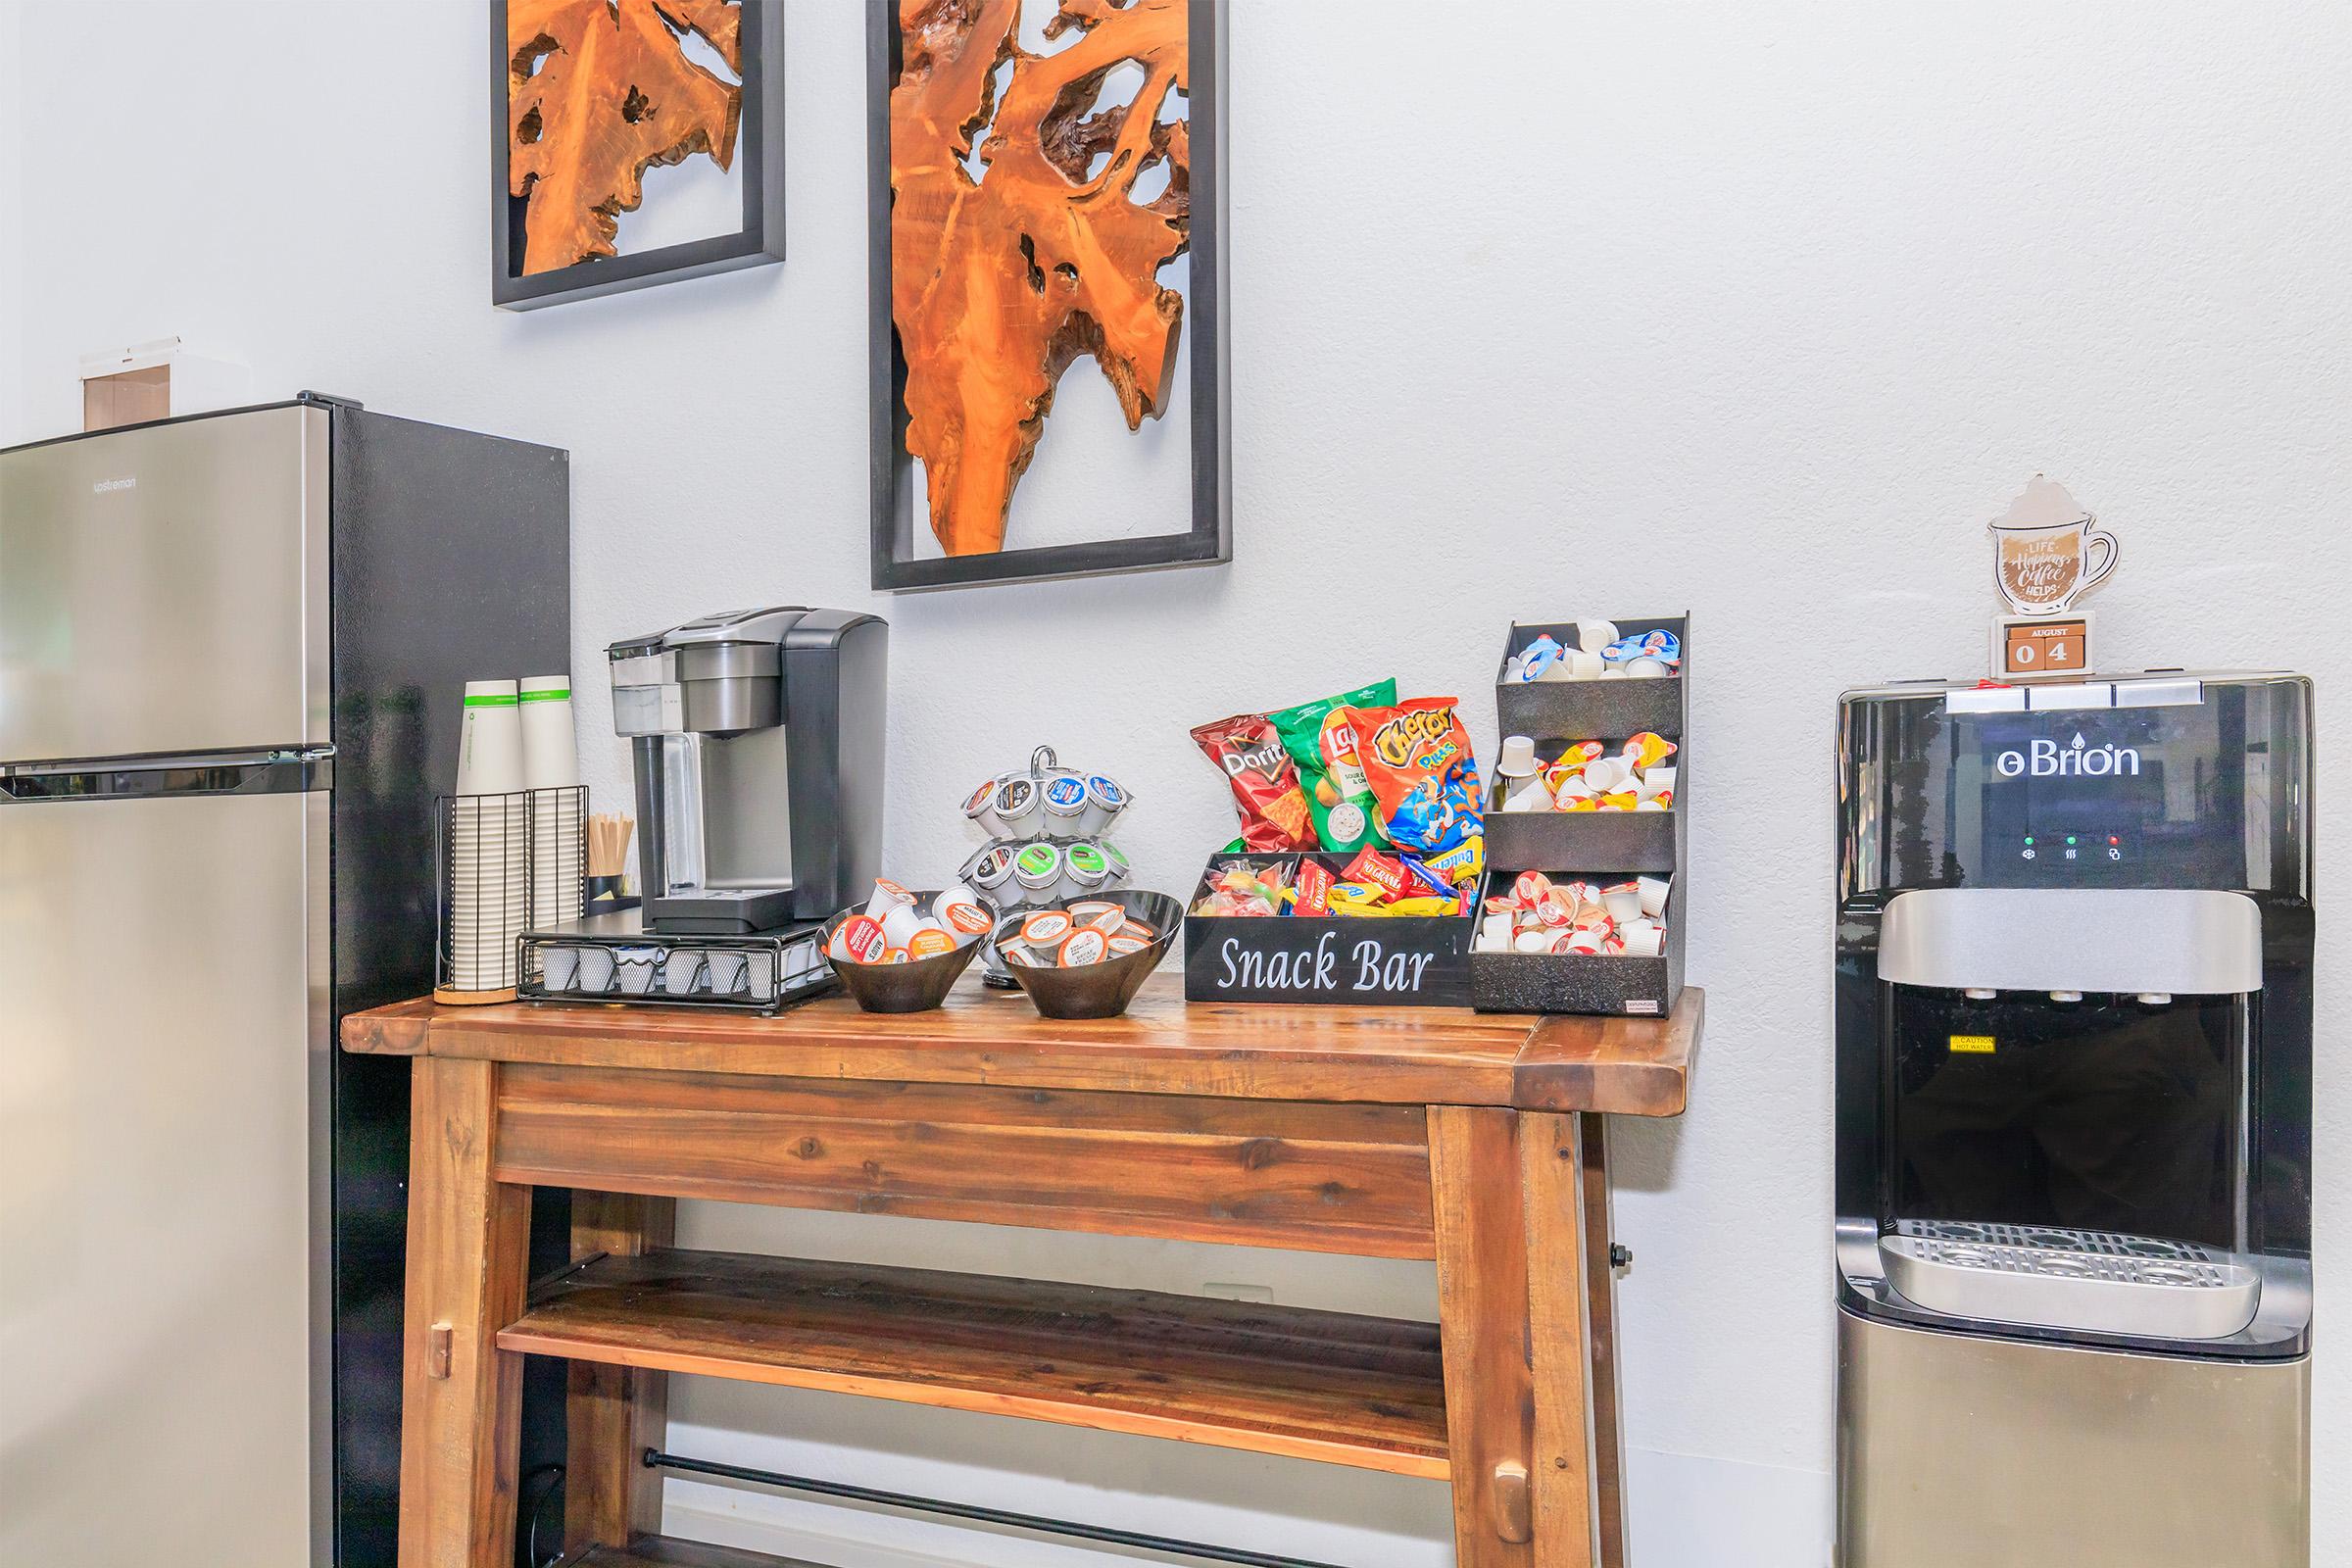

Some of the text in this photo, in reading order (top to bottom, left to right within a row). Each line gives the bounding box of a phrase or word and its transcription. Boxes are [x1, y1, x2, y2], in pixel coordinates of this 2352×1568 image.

[2029, 541, 2055, 554] LIFE
[2017, 564, 2065, 587] Coffee
[2025, 585, 2057, 597] HELPS
[2032, 628, 2069, 637] AUGUST
[1325, 726, 1352, 759] La
[1222, 743, 1285, 776] Dorit
[1217, 931, 1435, 992] Snack Bar
